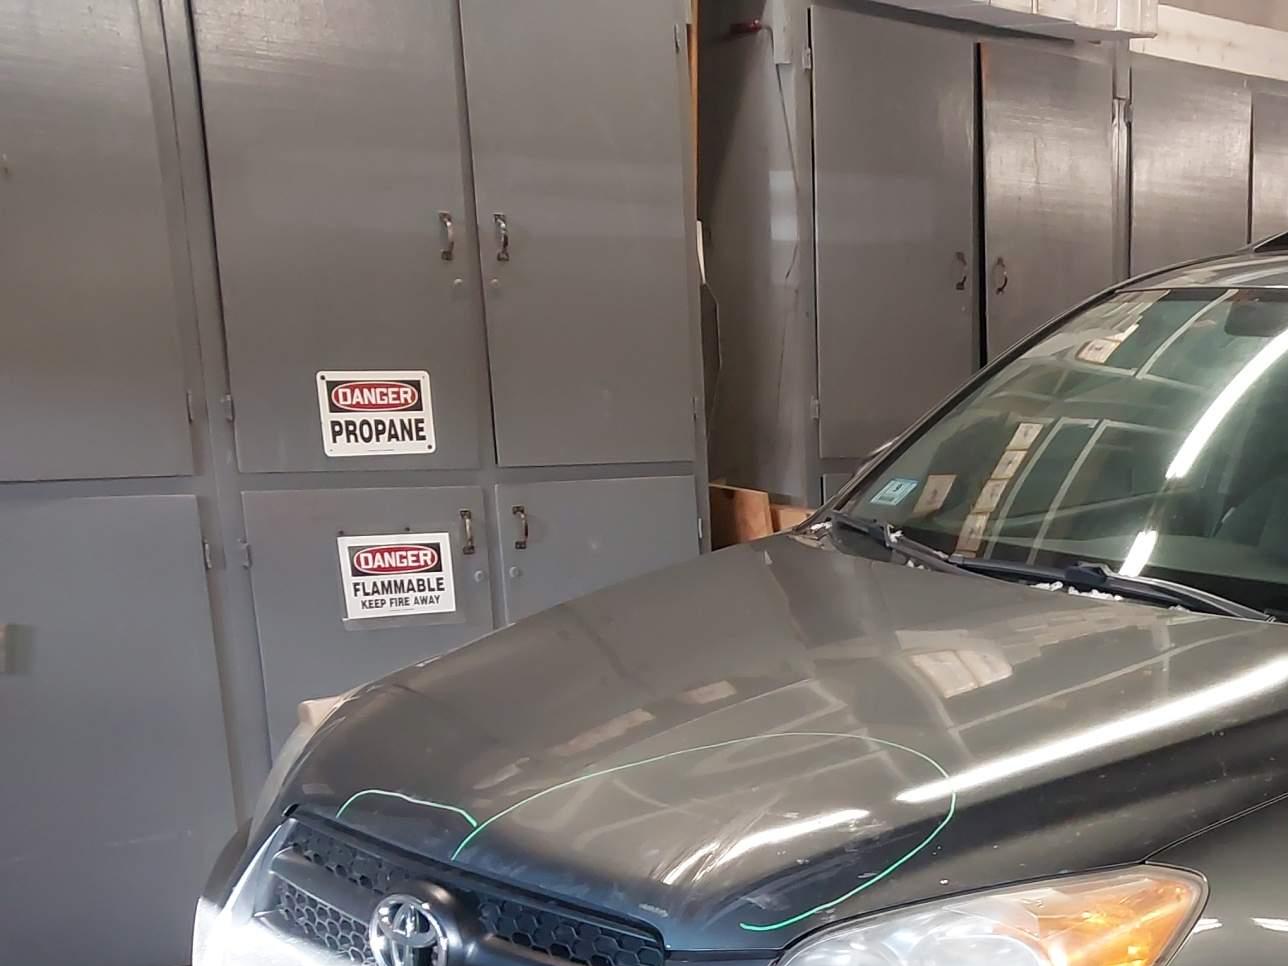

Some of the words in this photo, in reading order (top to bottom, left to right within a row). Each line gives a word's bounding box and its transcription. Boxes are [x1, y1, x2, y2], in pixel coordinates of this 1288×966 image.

[338, 387, 412, 405] DANGER
[330, 418, 427, 443] PROPANE
[360, 550, 433, 569] DANGER
[352, 577, 445, 597] FLAMMABLE
[361, 598, 387, 609] KEEP
[389, 596, 410, 607] FIRE
[414, 595, 441, 606] AWAY
